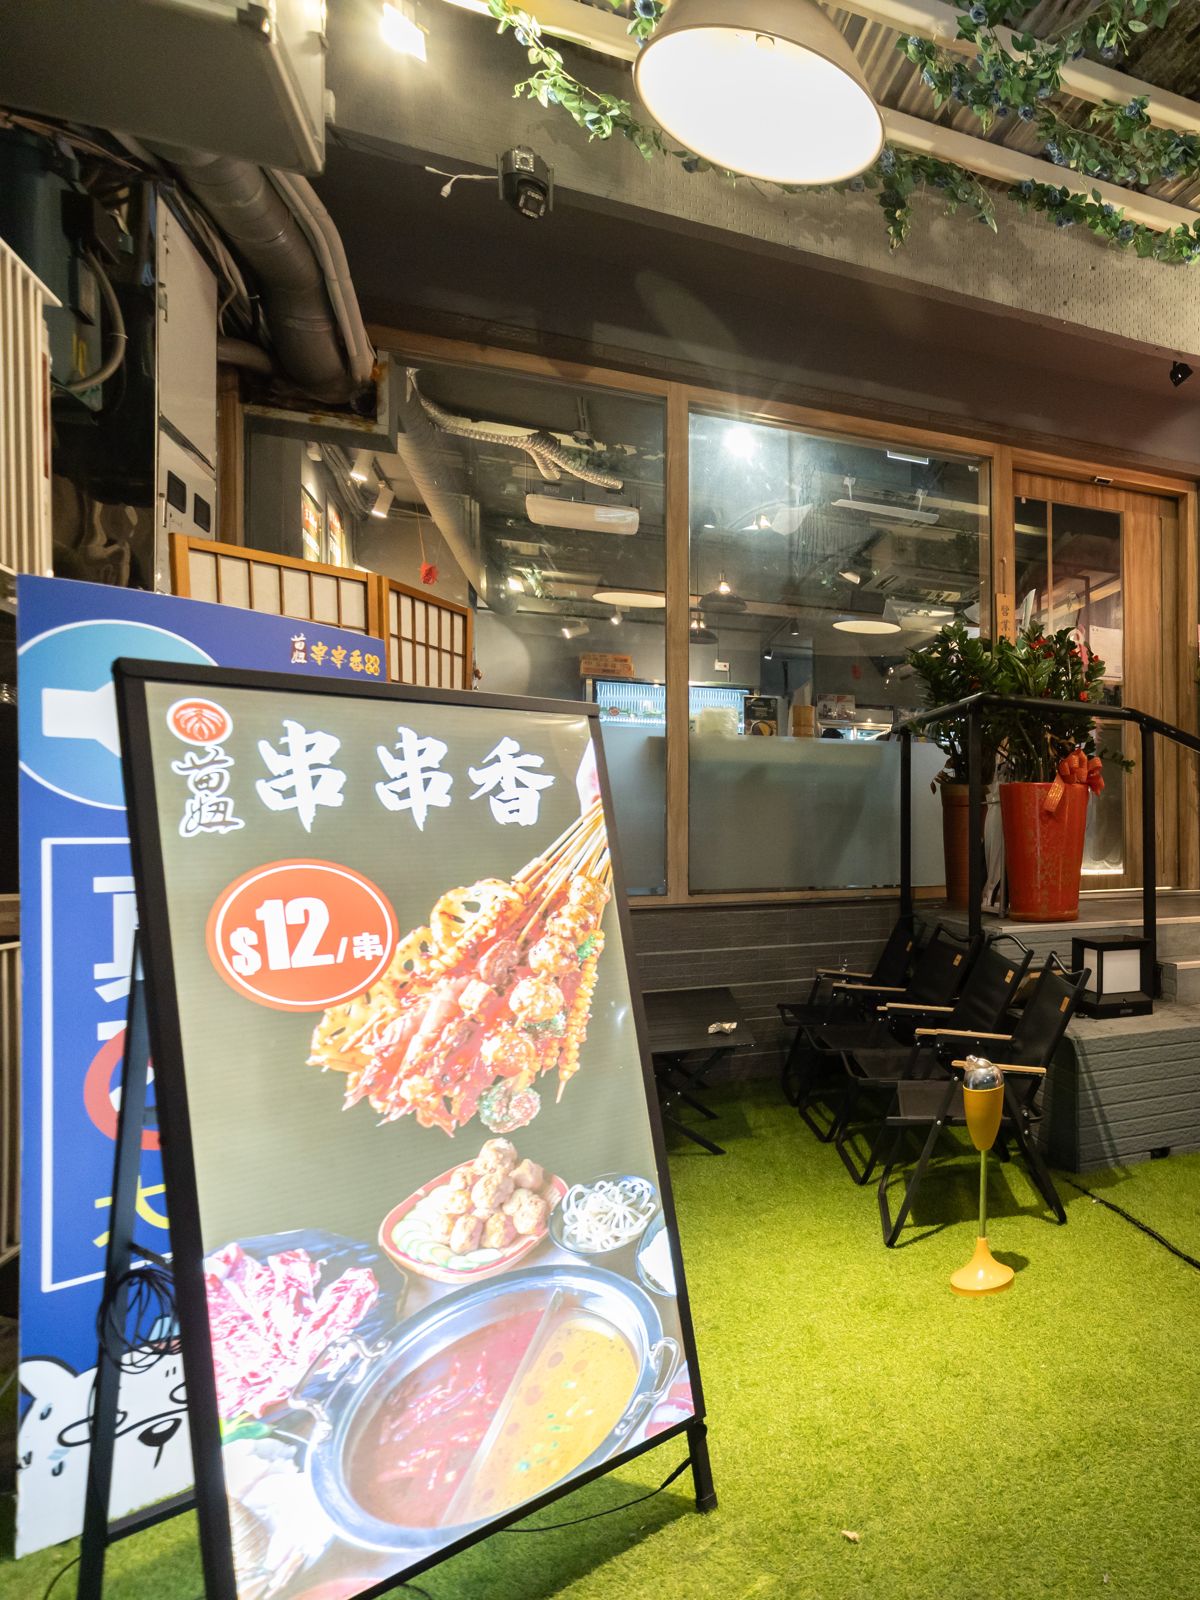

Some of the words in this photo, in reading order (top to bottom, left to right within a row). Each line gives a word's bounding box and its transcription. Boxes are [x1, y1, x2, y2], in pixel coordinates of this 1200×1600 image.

[172, 744, 245, 838] 苗妞
[255, 718, 556, 834] 串串香
[229, 896, 384, 977] $12/串
